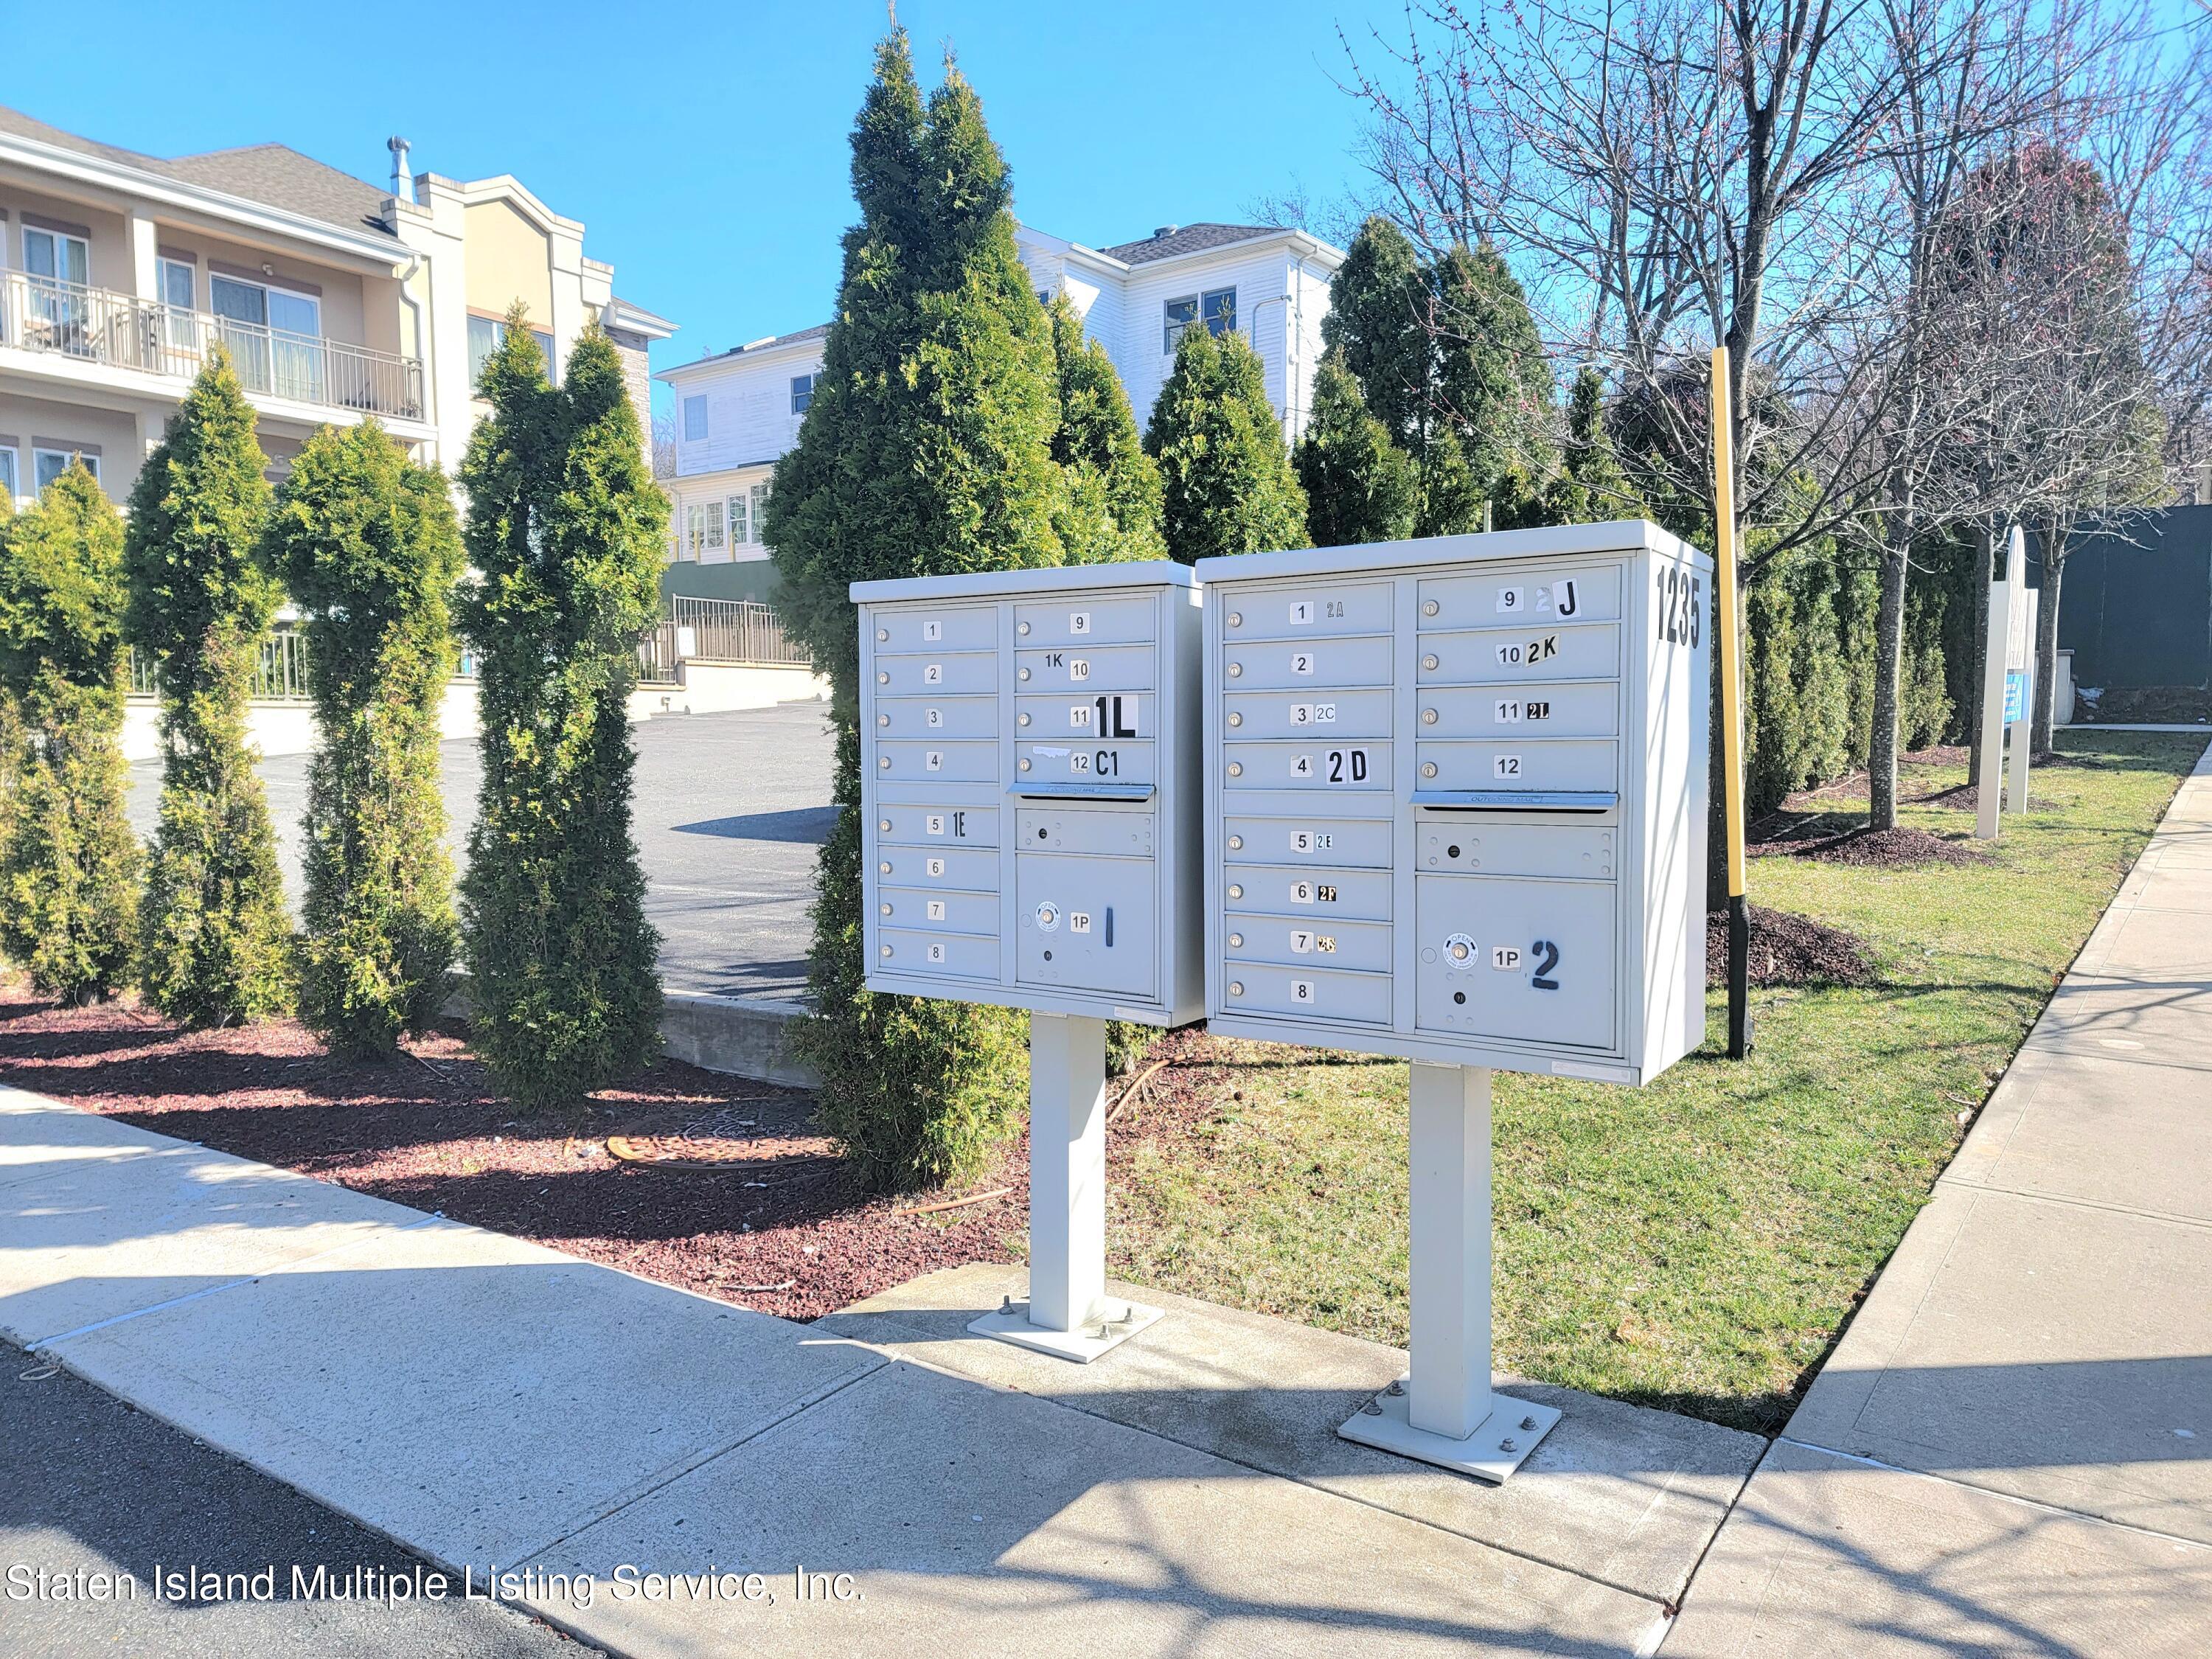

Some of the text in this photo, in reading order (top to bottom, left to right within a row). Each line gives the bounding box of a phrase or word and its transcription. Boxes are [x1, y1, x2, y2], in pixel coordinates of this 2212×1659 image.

[1505, 591, 1515, 607] 9
[1298, 602, 1344, 619] 1 2A
[1658, 565, 1700, 650] 1235
[929, 624, 935, 636] 1
[1076, 616, 1084, 630] 9
[1499, 636, 1556, 664] 10 2K
[1046, 653, 1088, 676] 1K 10
[1297, 657, 1307, 671] 2
[930, 668, 936, 680] 2
[931, 711, 937, 723] 3
[1073, 696, 1136, 738] 11 1L
[1298, 707, 1335, 722] 3 2C
[1499, 703, 1548, 719] 11 2L
[931, 754, 939, 767] 4
[1074, 750, 1118, 776] 12 C1
[1297, 751, 1366, 783] 4 2D
[1498, 759, 1519, 774] 12
[932, 811, 965, 837] 5 1E
[1298, 835, 1332, 849] 5 2E
[932, 862, 939, 874] 6
[1298, 885, 1336, 901] 6 2F
[933, 904, 939, 916] 7
[1073, 915, 1089, 928] 1P
[1298, 935, 1307, 948] 7
[1452, 934, 1470, 943] OPEN
[933, 946, 939, 959] 8
[1496, 950, 1519, 966] 1P
[1532, 940, 1559, 990] 2
[1298, 984, 1307, 998] 8
